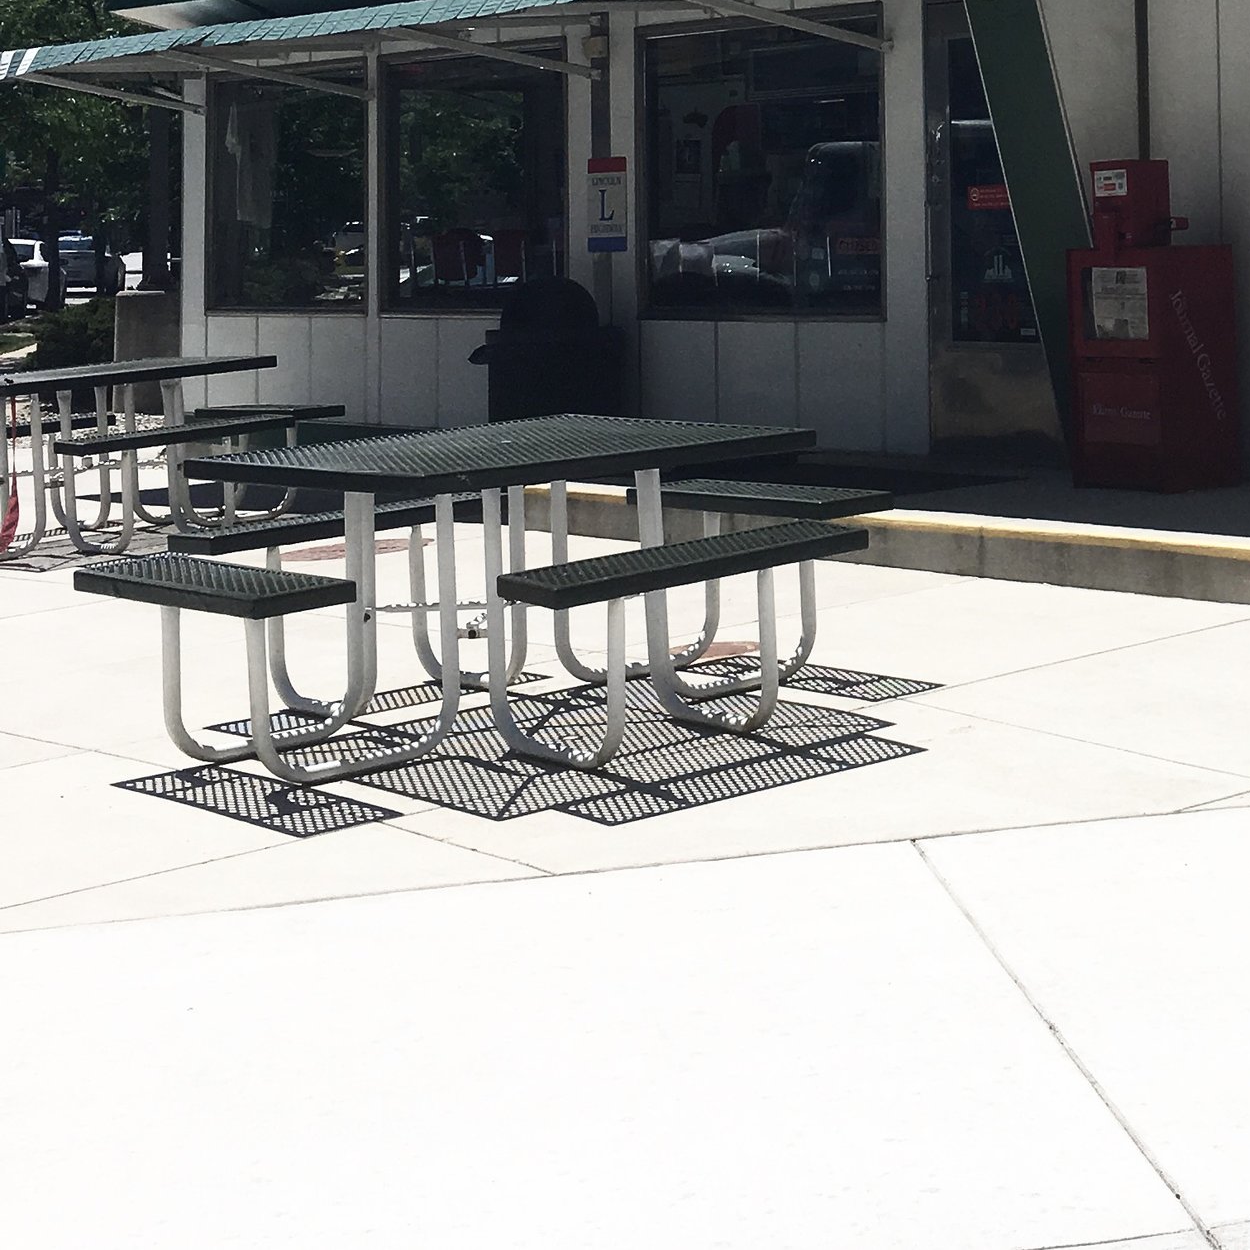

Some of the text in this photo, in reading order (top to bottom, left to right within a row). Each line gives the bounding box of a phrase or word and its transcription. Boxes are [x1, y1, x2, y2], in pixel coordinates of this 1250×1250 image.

[599, 190, 615, 221] L
[1170, 290, 1226, 420] Journal Gazette
